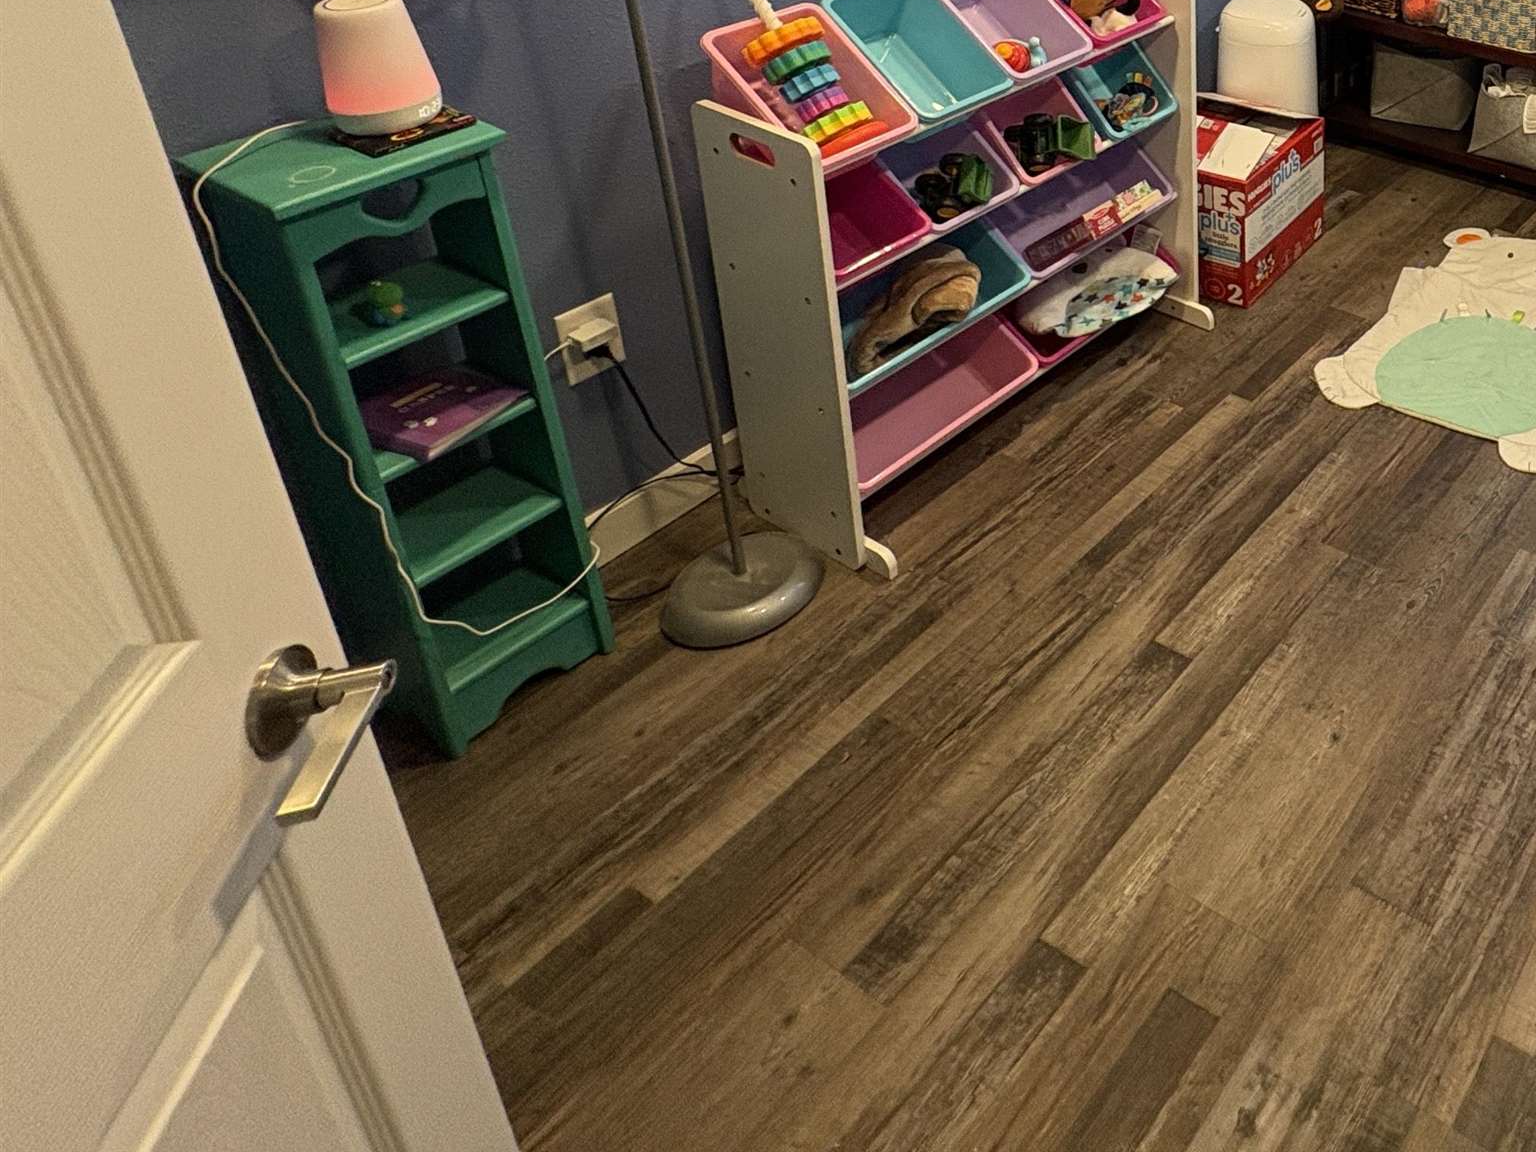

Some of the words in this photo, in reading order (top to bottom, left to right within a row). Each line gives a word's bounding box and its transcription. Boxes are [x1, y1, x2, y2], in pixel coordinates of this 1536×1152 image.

[1272, 155, 1300, 195] plus
[1199, 212, 1241, 236] plus
[1227, 283, 1244, 306] 2
